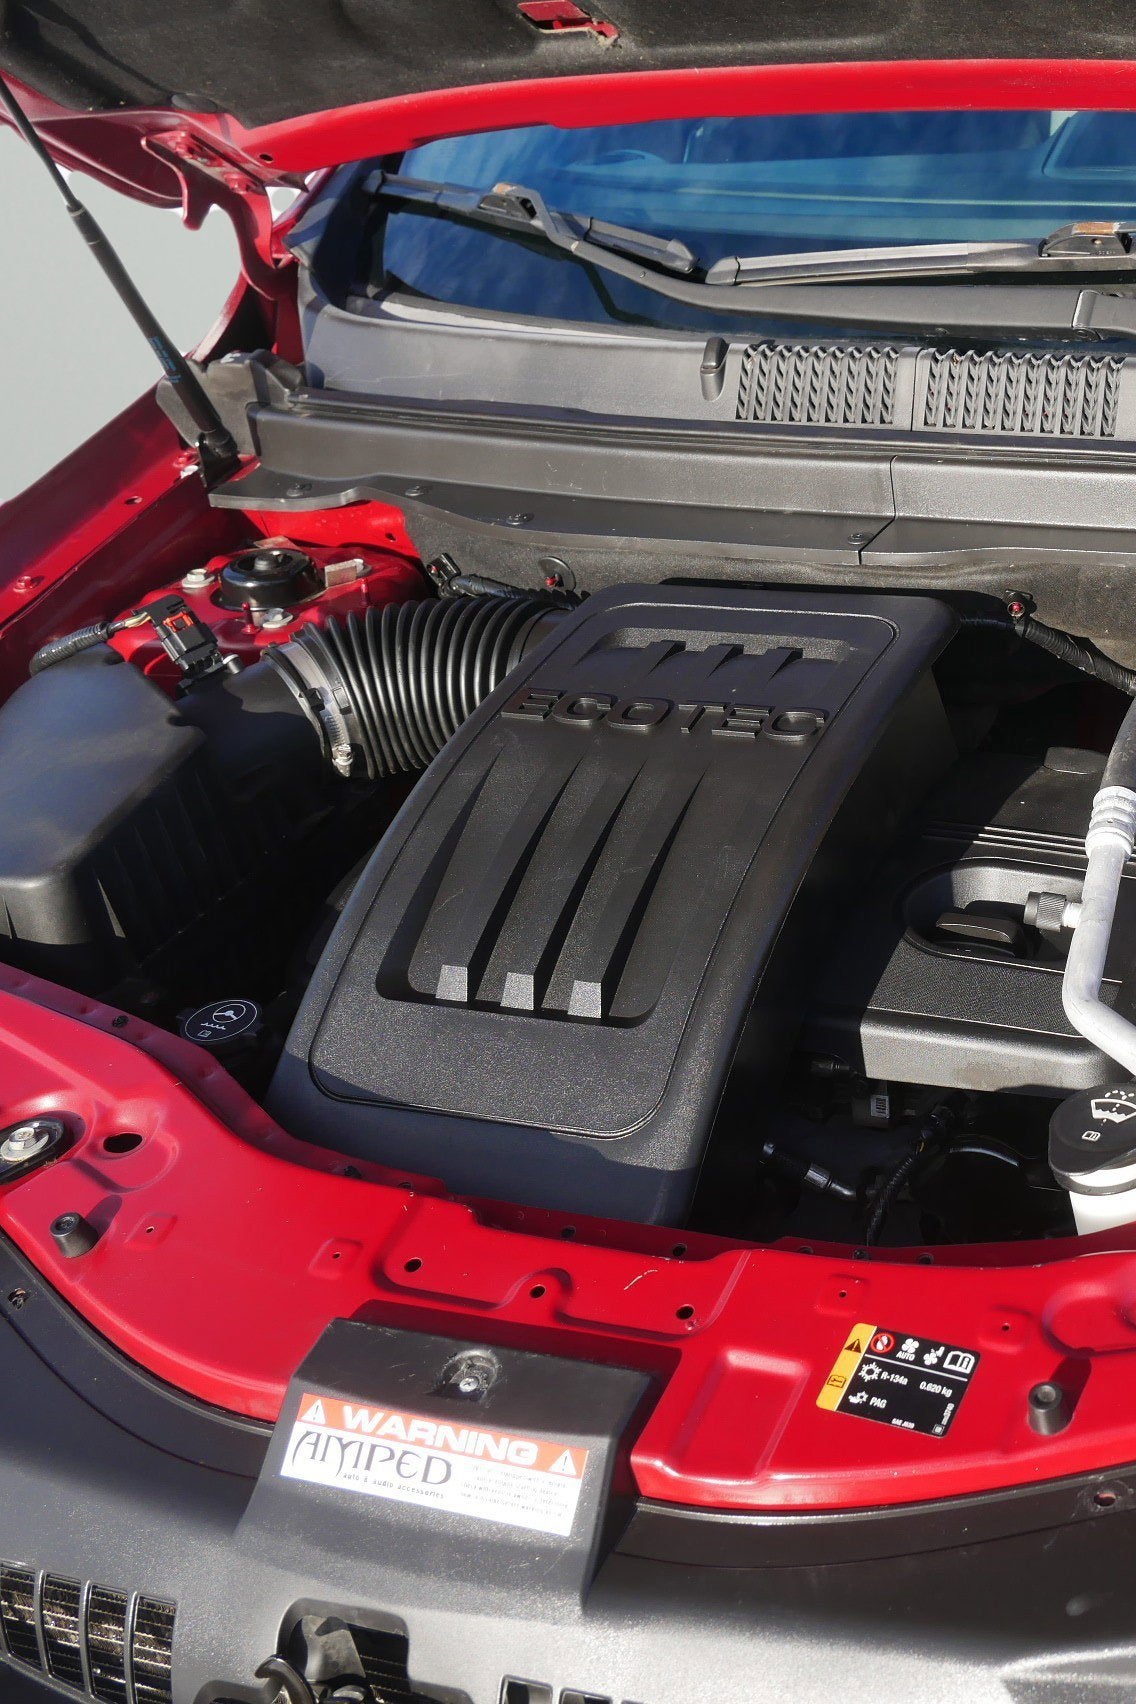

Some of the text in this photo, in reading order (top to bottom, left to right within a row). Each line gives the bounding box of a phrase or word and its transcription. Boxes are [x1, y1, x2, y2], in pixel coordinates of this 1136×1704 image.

[501, 687, 829, 743] ECOTEC
[895, 1351, 915, 1362] AUTO
[880, 1371, 908, 1386] R-134a
[941, 1386, 953, 1398] kg
[869, 1396, 887, 1408] PAG
[342, 1404, 539, 1466] WARNING
[292, 1430, 453, 1486] AMPED
[397, 1483, 445, 1500] accessories
